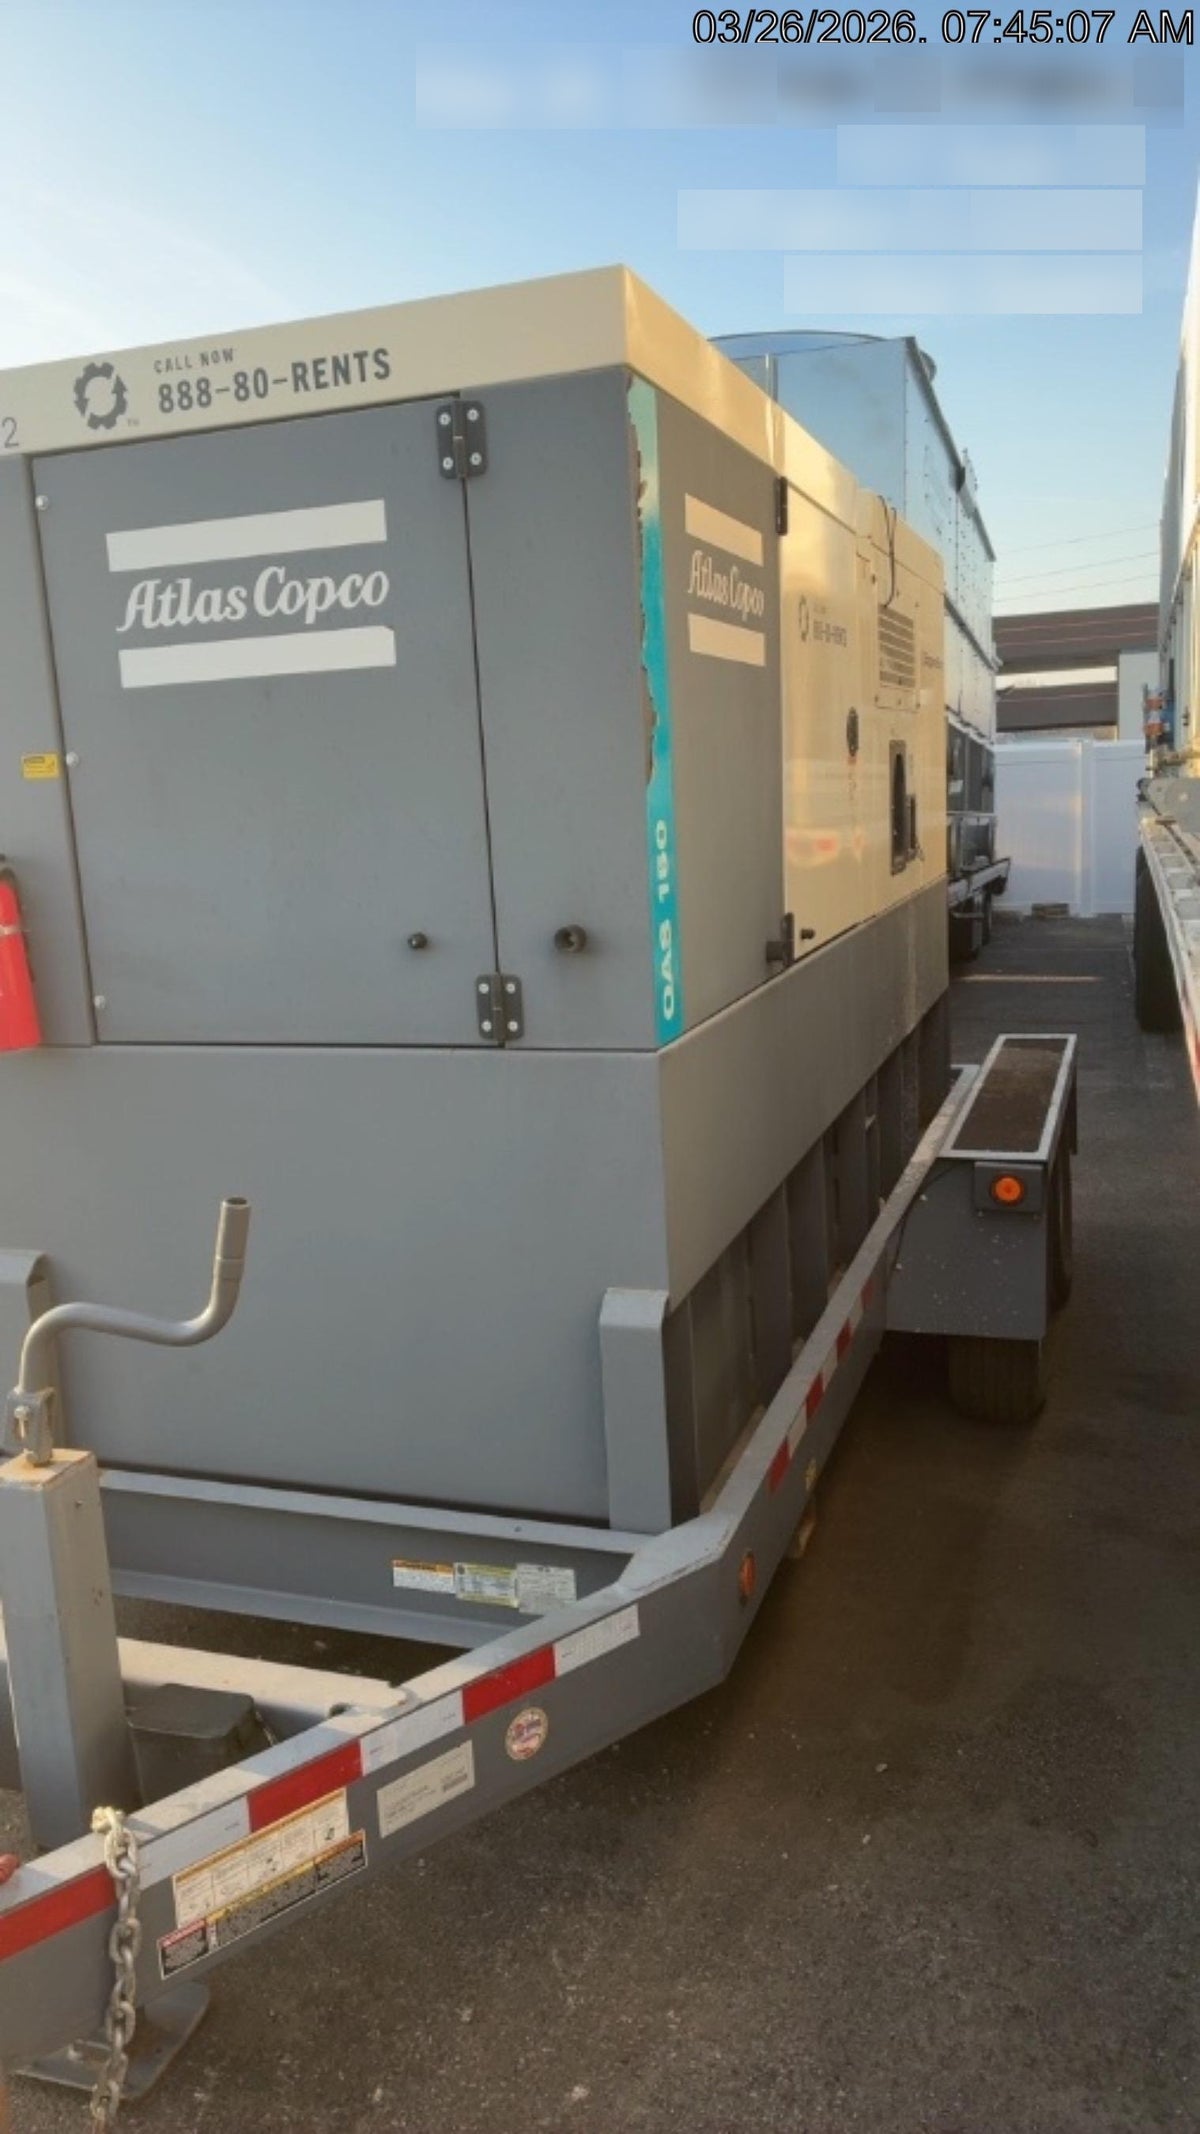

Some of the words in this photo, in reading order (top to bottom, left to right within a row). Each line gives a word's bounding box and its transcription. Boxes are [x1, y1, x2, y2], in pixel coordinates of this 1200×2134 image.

[154, 356, 193, 374] CALL
[200, 347, 235, 367] NOW
[158, 348, 391, 413] 888-80-RENTS
[1, 417, 20, 448] 2
[115, 578, 248, 632] Atlas
[253, 566, 390, 624] Copco
[687, 550, 728, 605] Atlas
[730, 564, 764, 621] Copco
